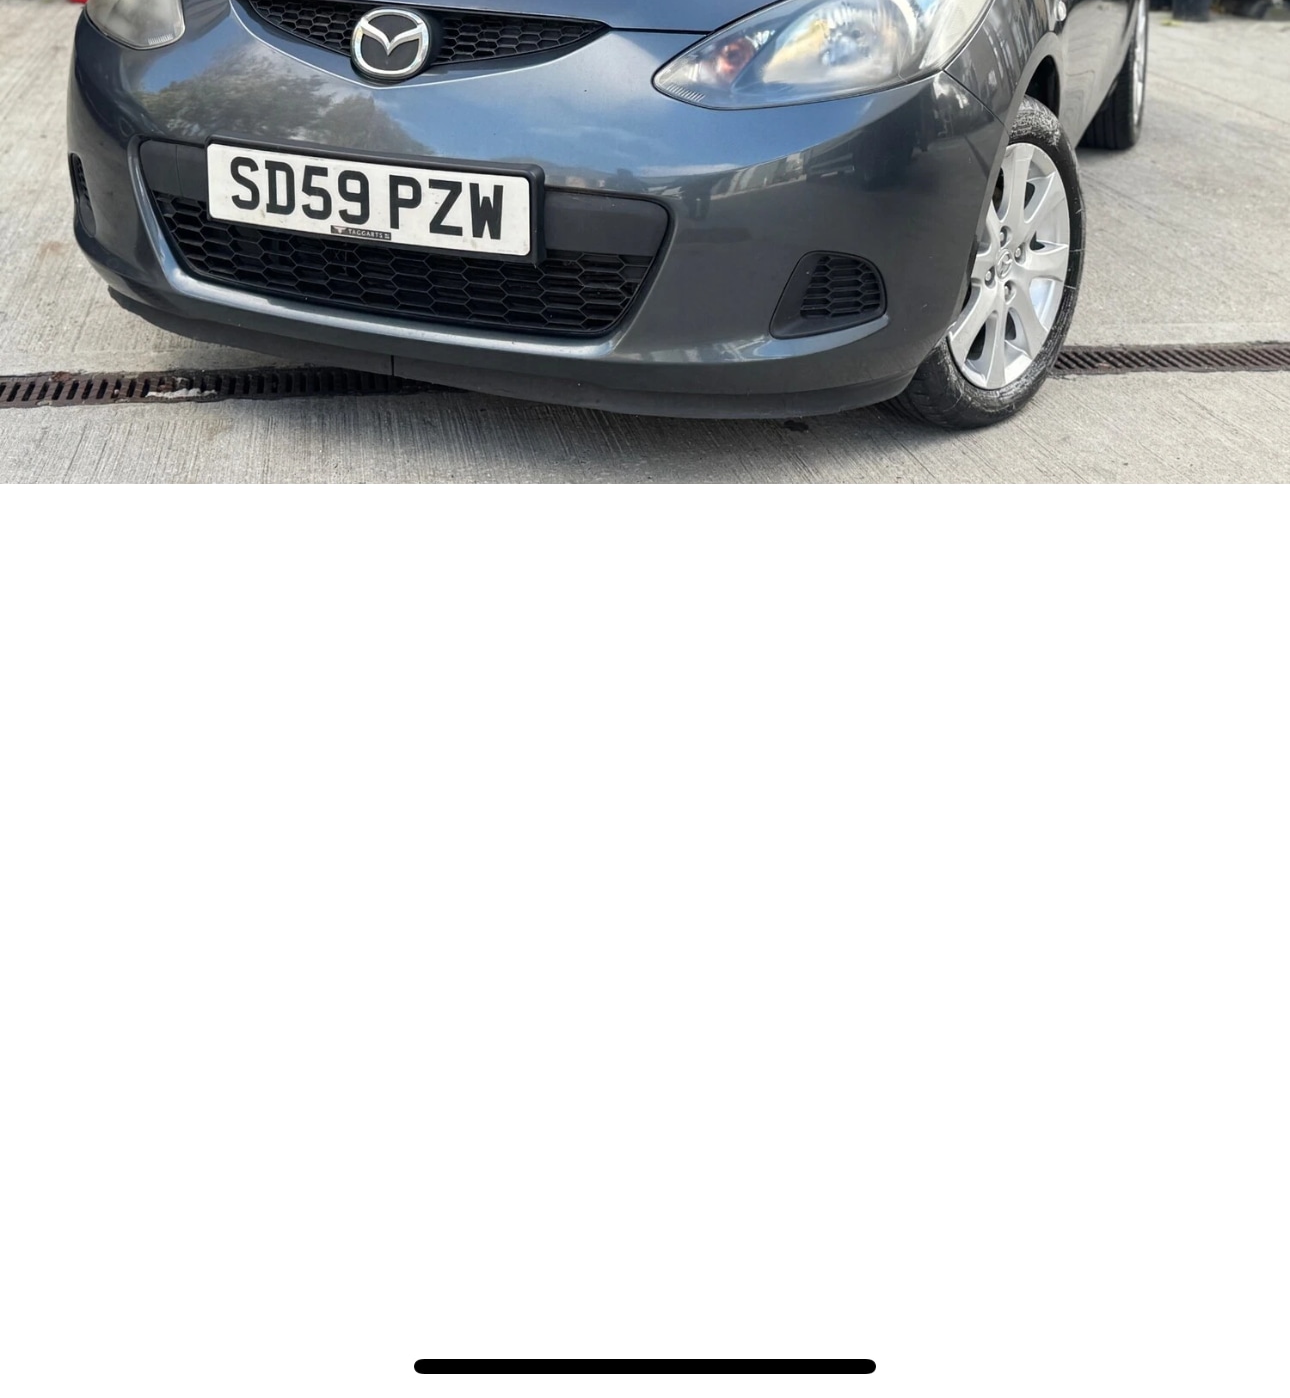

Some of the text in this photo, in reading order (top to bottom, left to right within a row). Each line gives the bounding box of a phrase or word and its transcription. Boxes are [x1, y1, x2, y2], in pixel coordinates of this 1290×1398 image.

[231, 156, 504, 240] SD59 PZW
[348, 228, 383, 239] TAGGARTS
